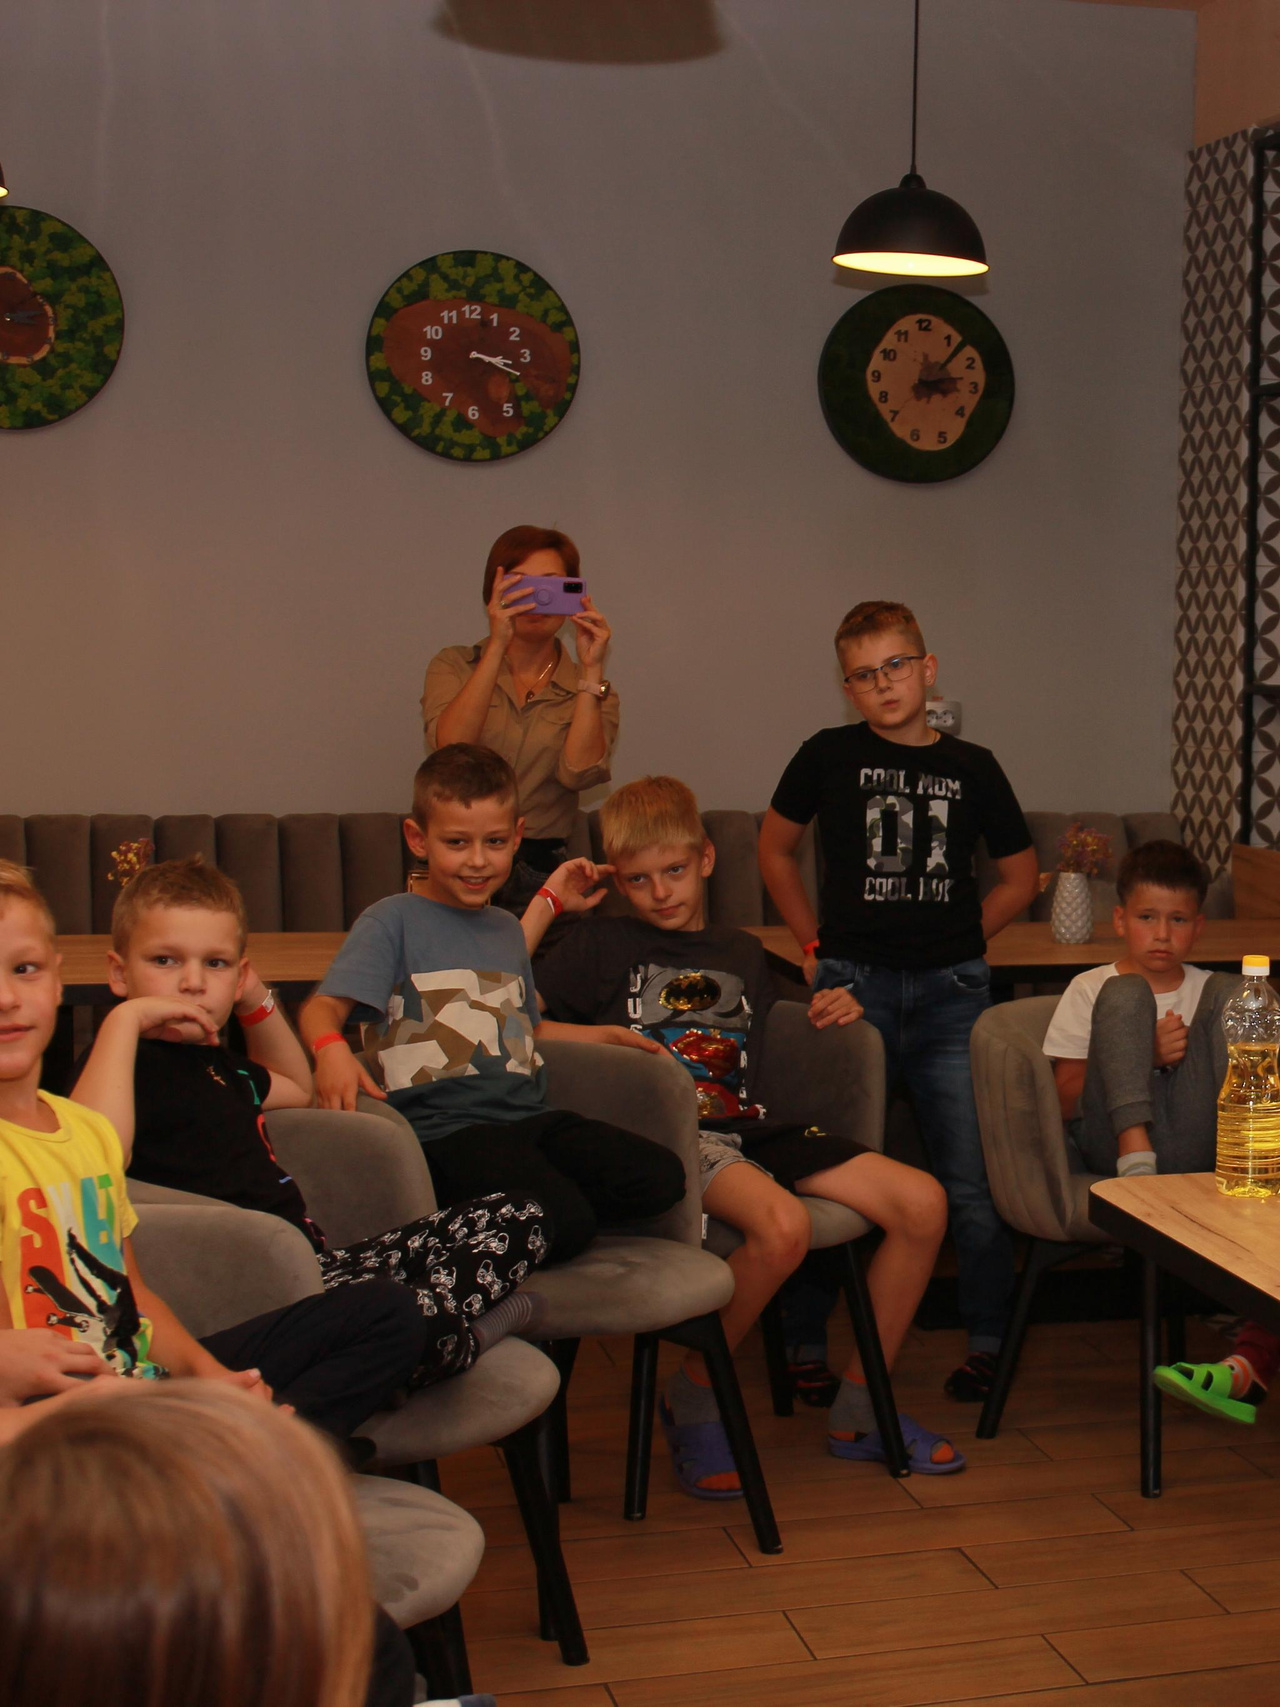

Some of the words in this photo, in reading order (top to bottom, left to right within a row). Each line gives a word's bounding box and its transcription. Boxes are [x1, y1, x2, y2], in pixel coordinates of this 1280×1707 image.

[440, 310, 458, 324] 11
[461, 305, 481, 319] 12
[489, 313, 498, 327] 1
[915, 318, 932, 332] 12
[423, 325, 443, 340] 10
[509, 327, 520, 341] 2
[894, 329, 909, 343] 11
[944, 334, 952, 347] 1
[420, 347, 432, 361] 9
[520, 349, 531, 363] 3
[880, 348, 897, 362] 10
[965, 356, 976, 370] 2
[421, 371, 433, 385] 8
[871, 370, 881, 383] 9
[969, 381, 979, 395] 3
[442, 392, 453, 406] 7
[878, 390, 888, 404] 8
[468, 406, 479, 420] 6
[502, 403, 514, 417] 5
[889, 409, 899, 422] 7
[955, 405, 965, 419] 4
[910, 429, 920, 442] 6
[937, 431, 947, 444] 5
[859, 768, 910, 793] COOL
[916, 771, 962, 799] MOM
[866, 795, 949, 874] 01
[863, 876, 912, 901] COOL
